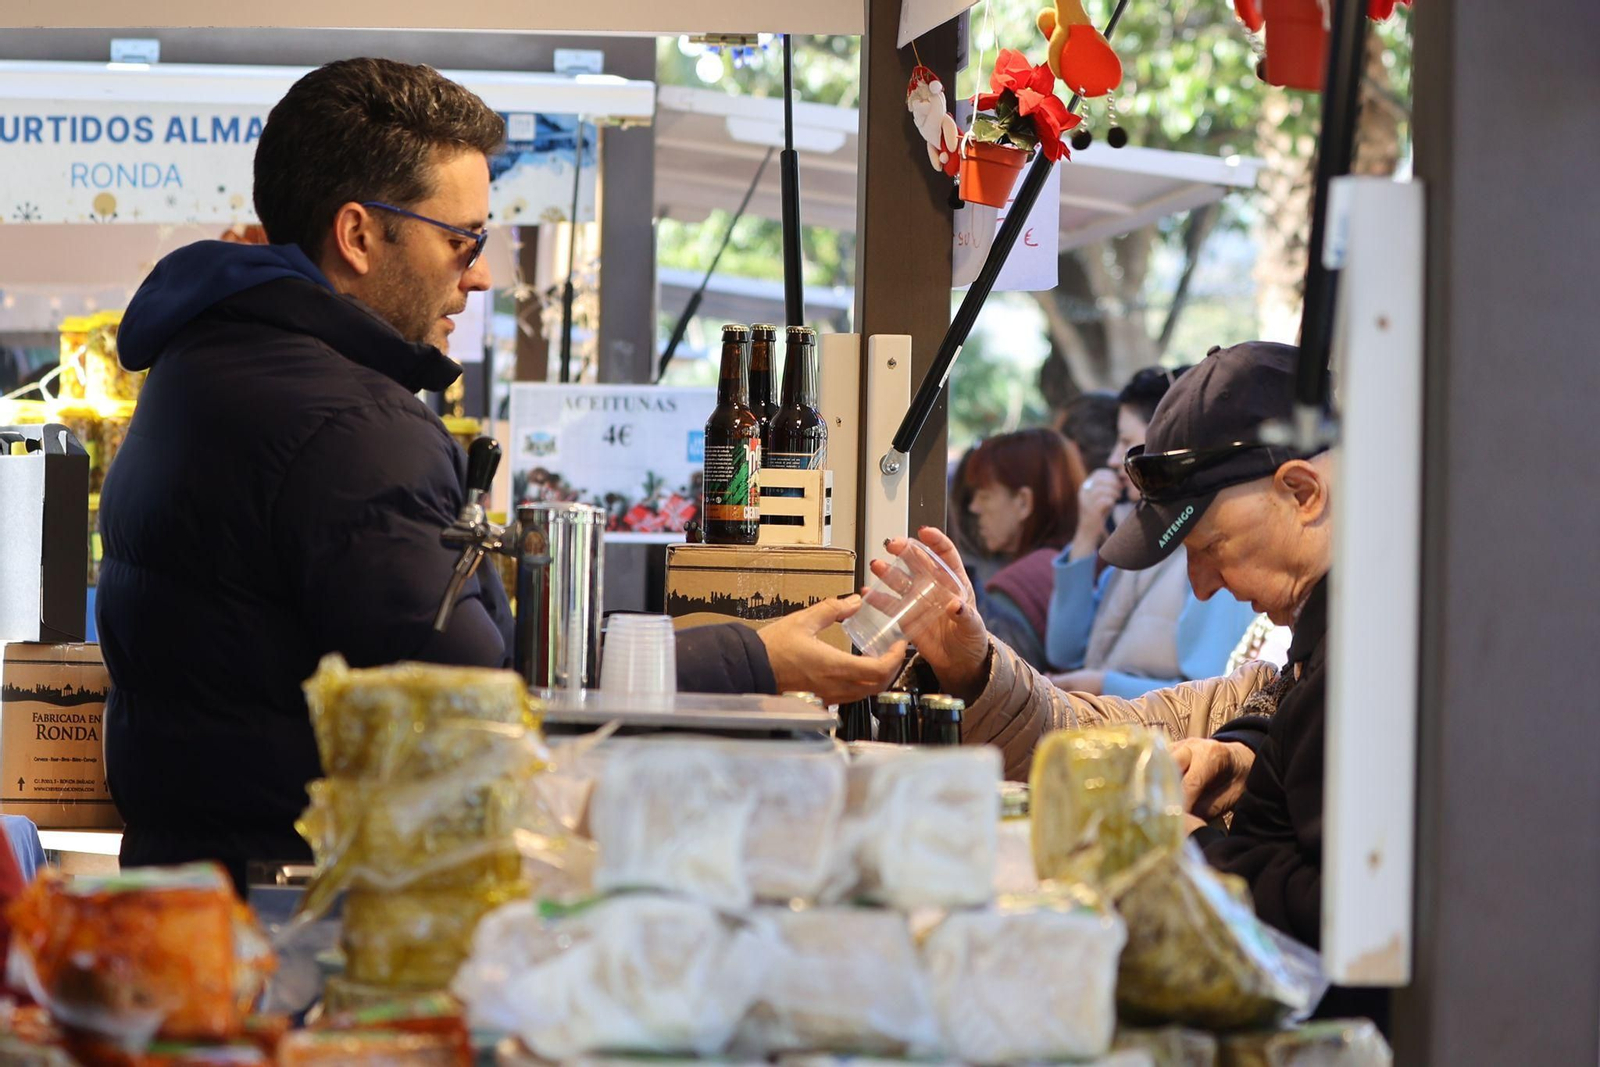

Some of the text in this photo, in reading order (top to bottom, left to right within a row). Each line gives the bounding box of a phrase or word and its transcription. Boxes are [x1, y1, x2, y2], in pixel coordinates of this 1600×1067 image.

[70, 162, 184, 189] RONDA
[564, 395, 678, 413] ACEITUNAS
[602, 423, 634, 448] 4€
[1158, 505, 1195, 549] ARTENGO
[32, 712, 101, 723] FABRICADA EN
[36, 724, 98, 741] RONDA
